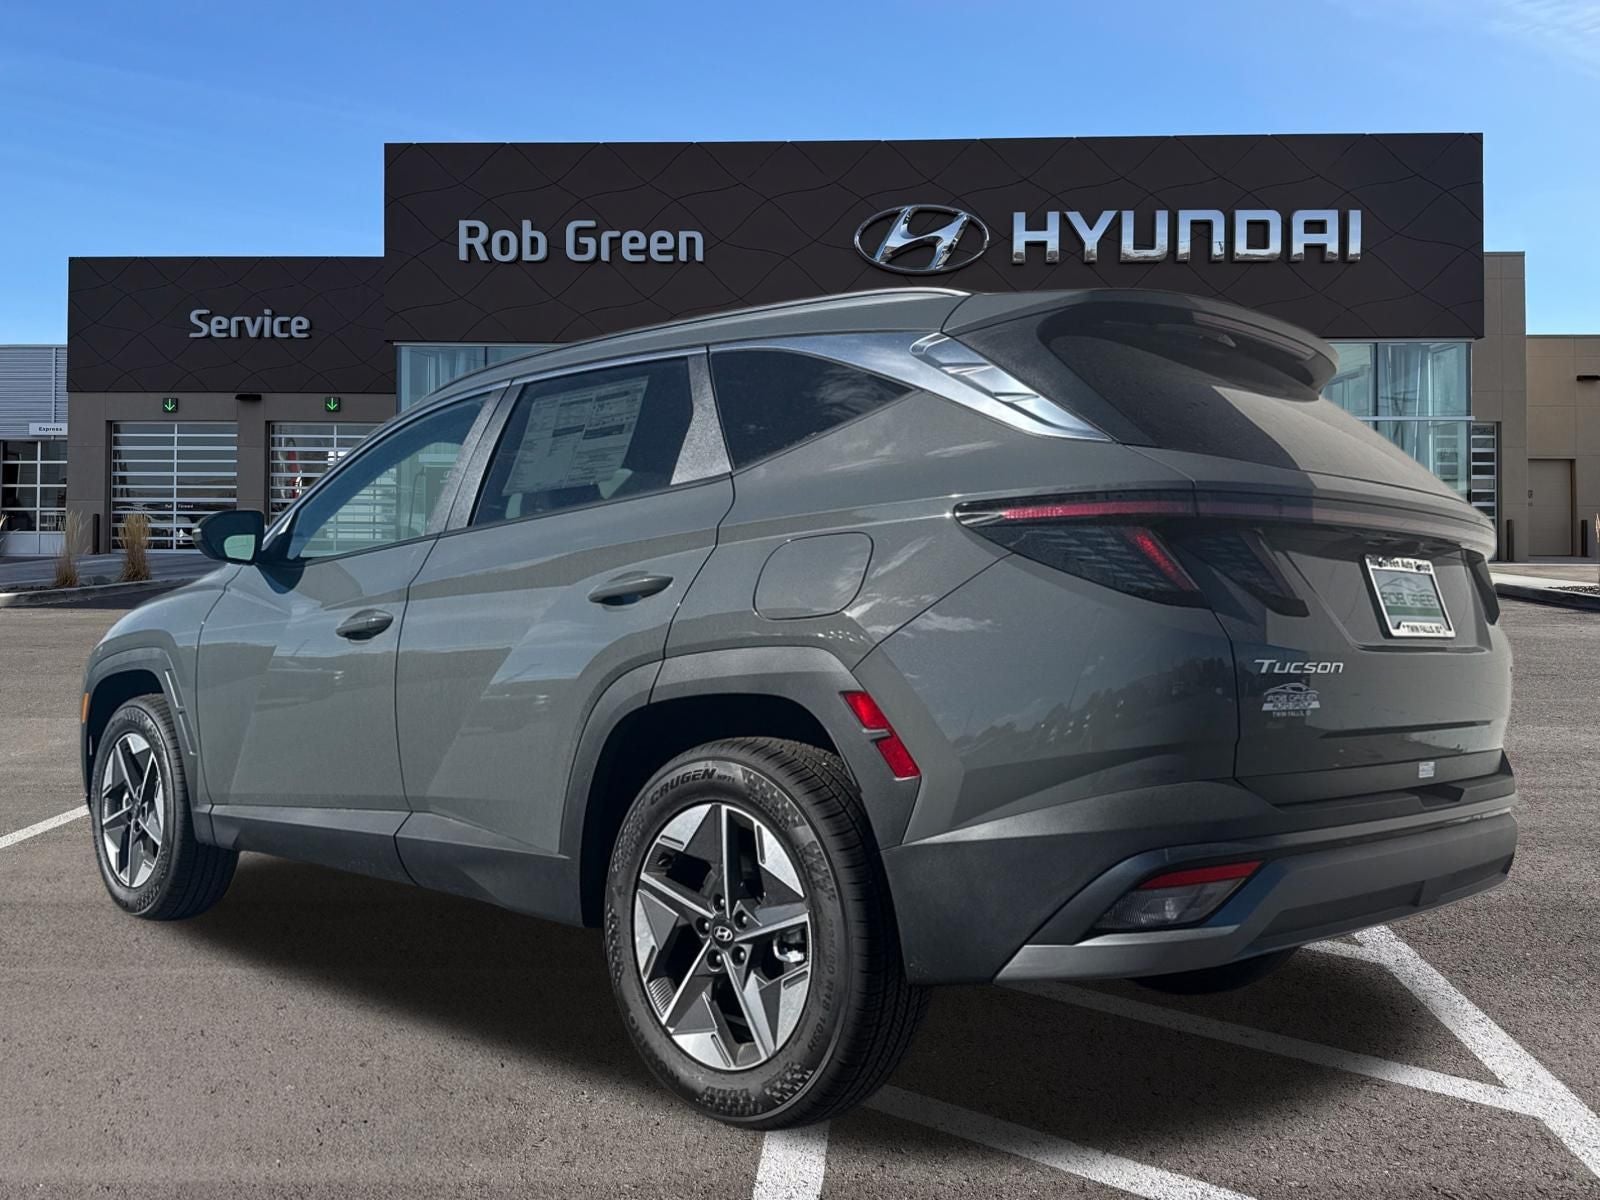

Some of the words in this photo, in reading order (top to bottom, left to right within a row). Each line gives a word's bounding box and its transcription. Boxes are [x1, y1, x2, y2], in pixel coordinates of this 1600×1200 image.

[458, 219, 548, 262] Rob
[565, 219, 704, 262] Green
[1012, 209, 1363, 264] HYUNDAI
[189, 309, 311, 338] Service
[1253, 659, 1344, 674] Tucson
[650, 768, 717, 805] CRUGEN
